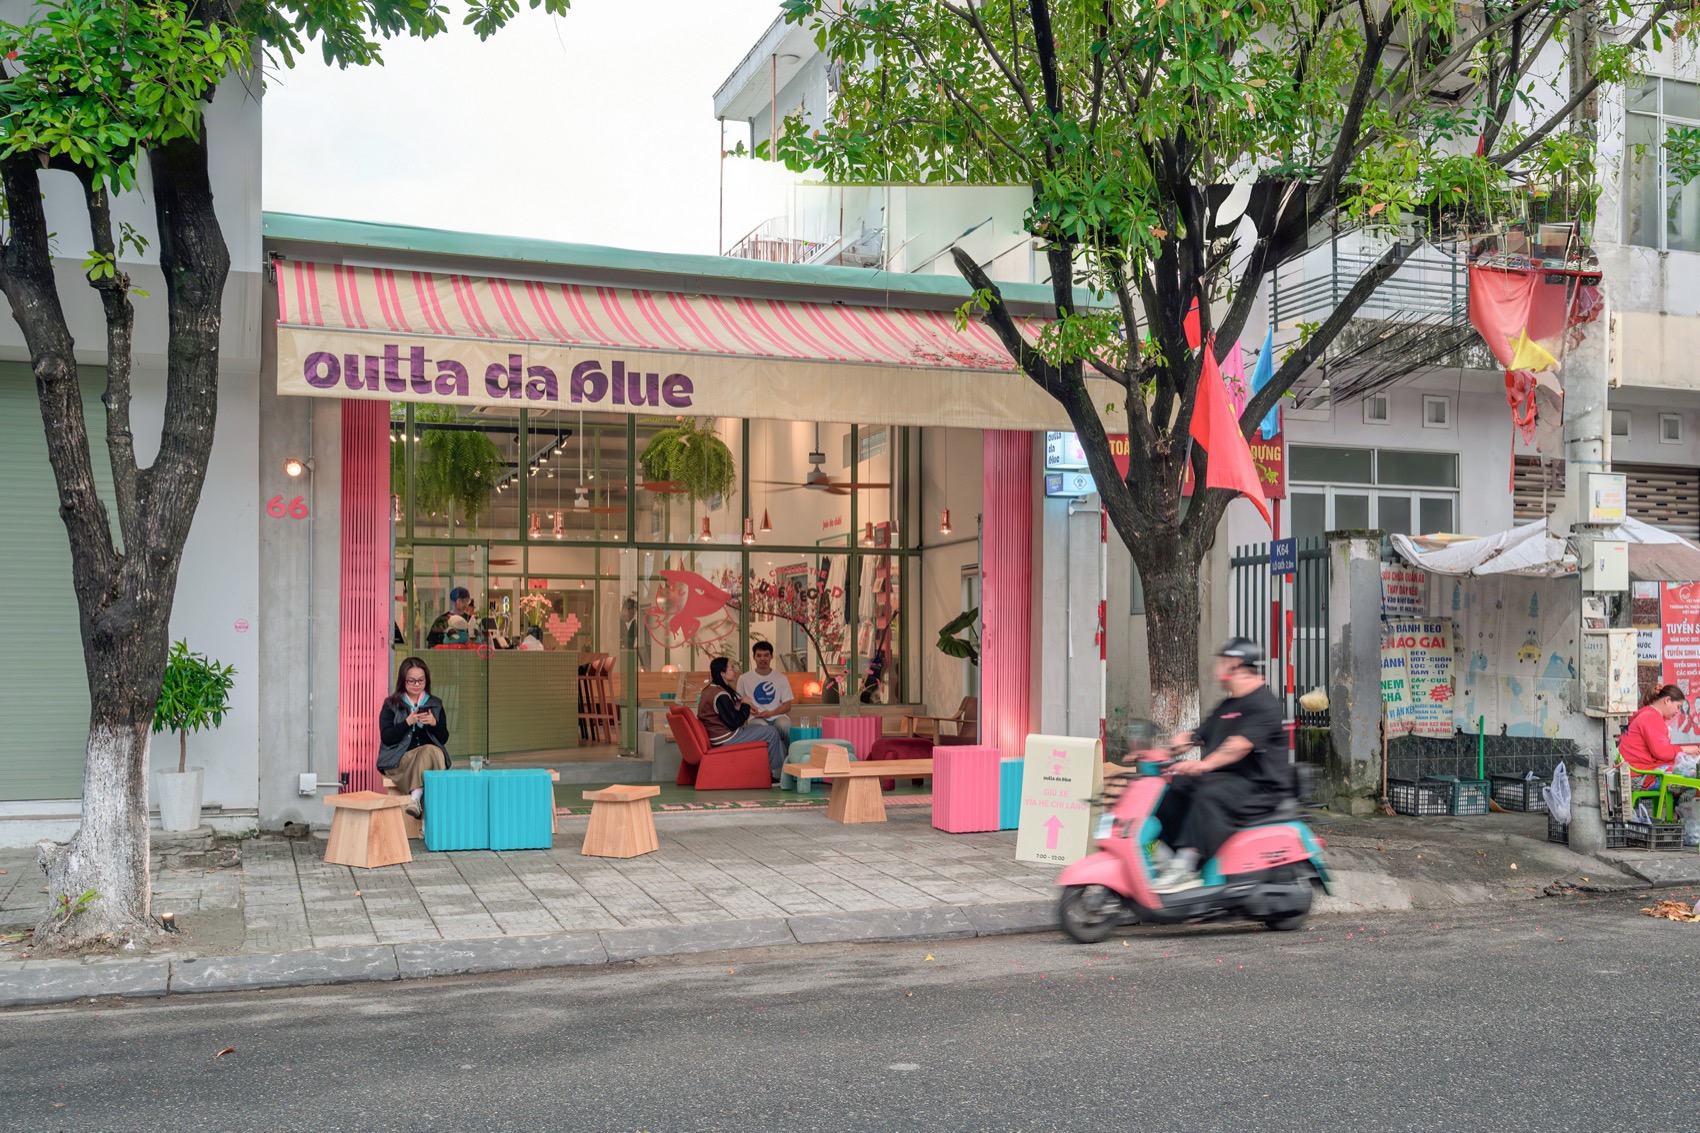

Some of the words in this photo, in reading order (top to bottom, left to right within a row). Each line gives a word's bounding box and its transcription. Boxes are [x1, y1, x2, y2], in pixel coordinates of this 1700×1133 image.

[303, 344, 470, 397] outta
[485, 353, 559, 401] da
[570, 360, 694, 408] blue
[1109, 439, 1130, 456] TOÀ
[267, 494, 309, 520] 66
[1276, 543, 1290, 557] K64
[769, 565, 807, 577] CHOOSE
[809, 567, 827, 579] THE
[1666, 618, 1694, 635] TUYỂN
[1380, 679, 1404, 690] NEM
